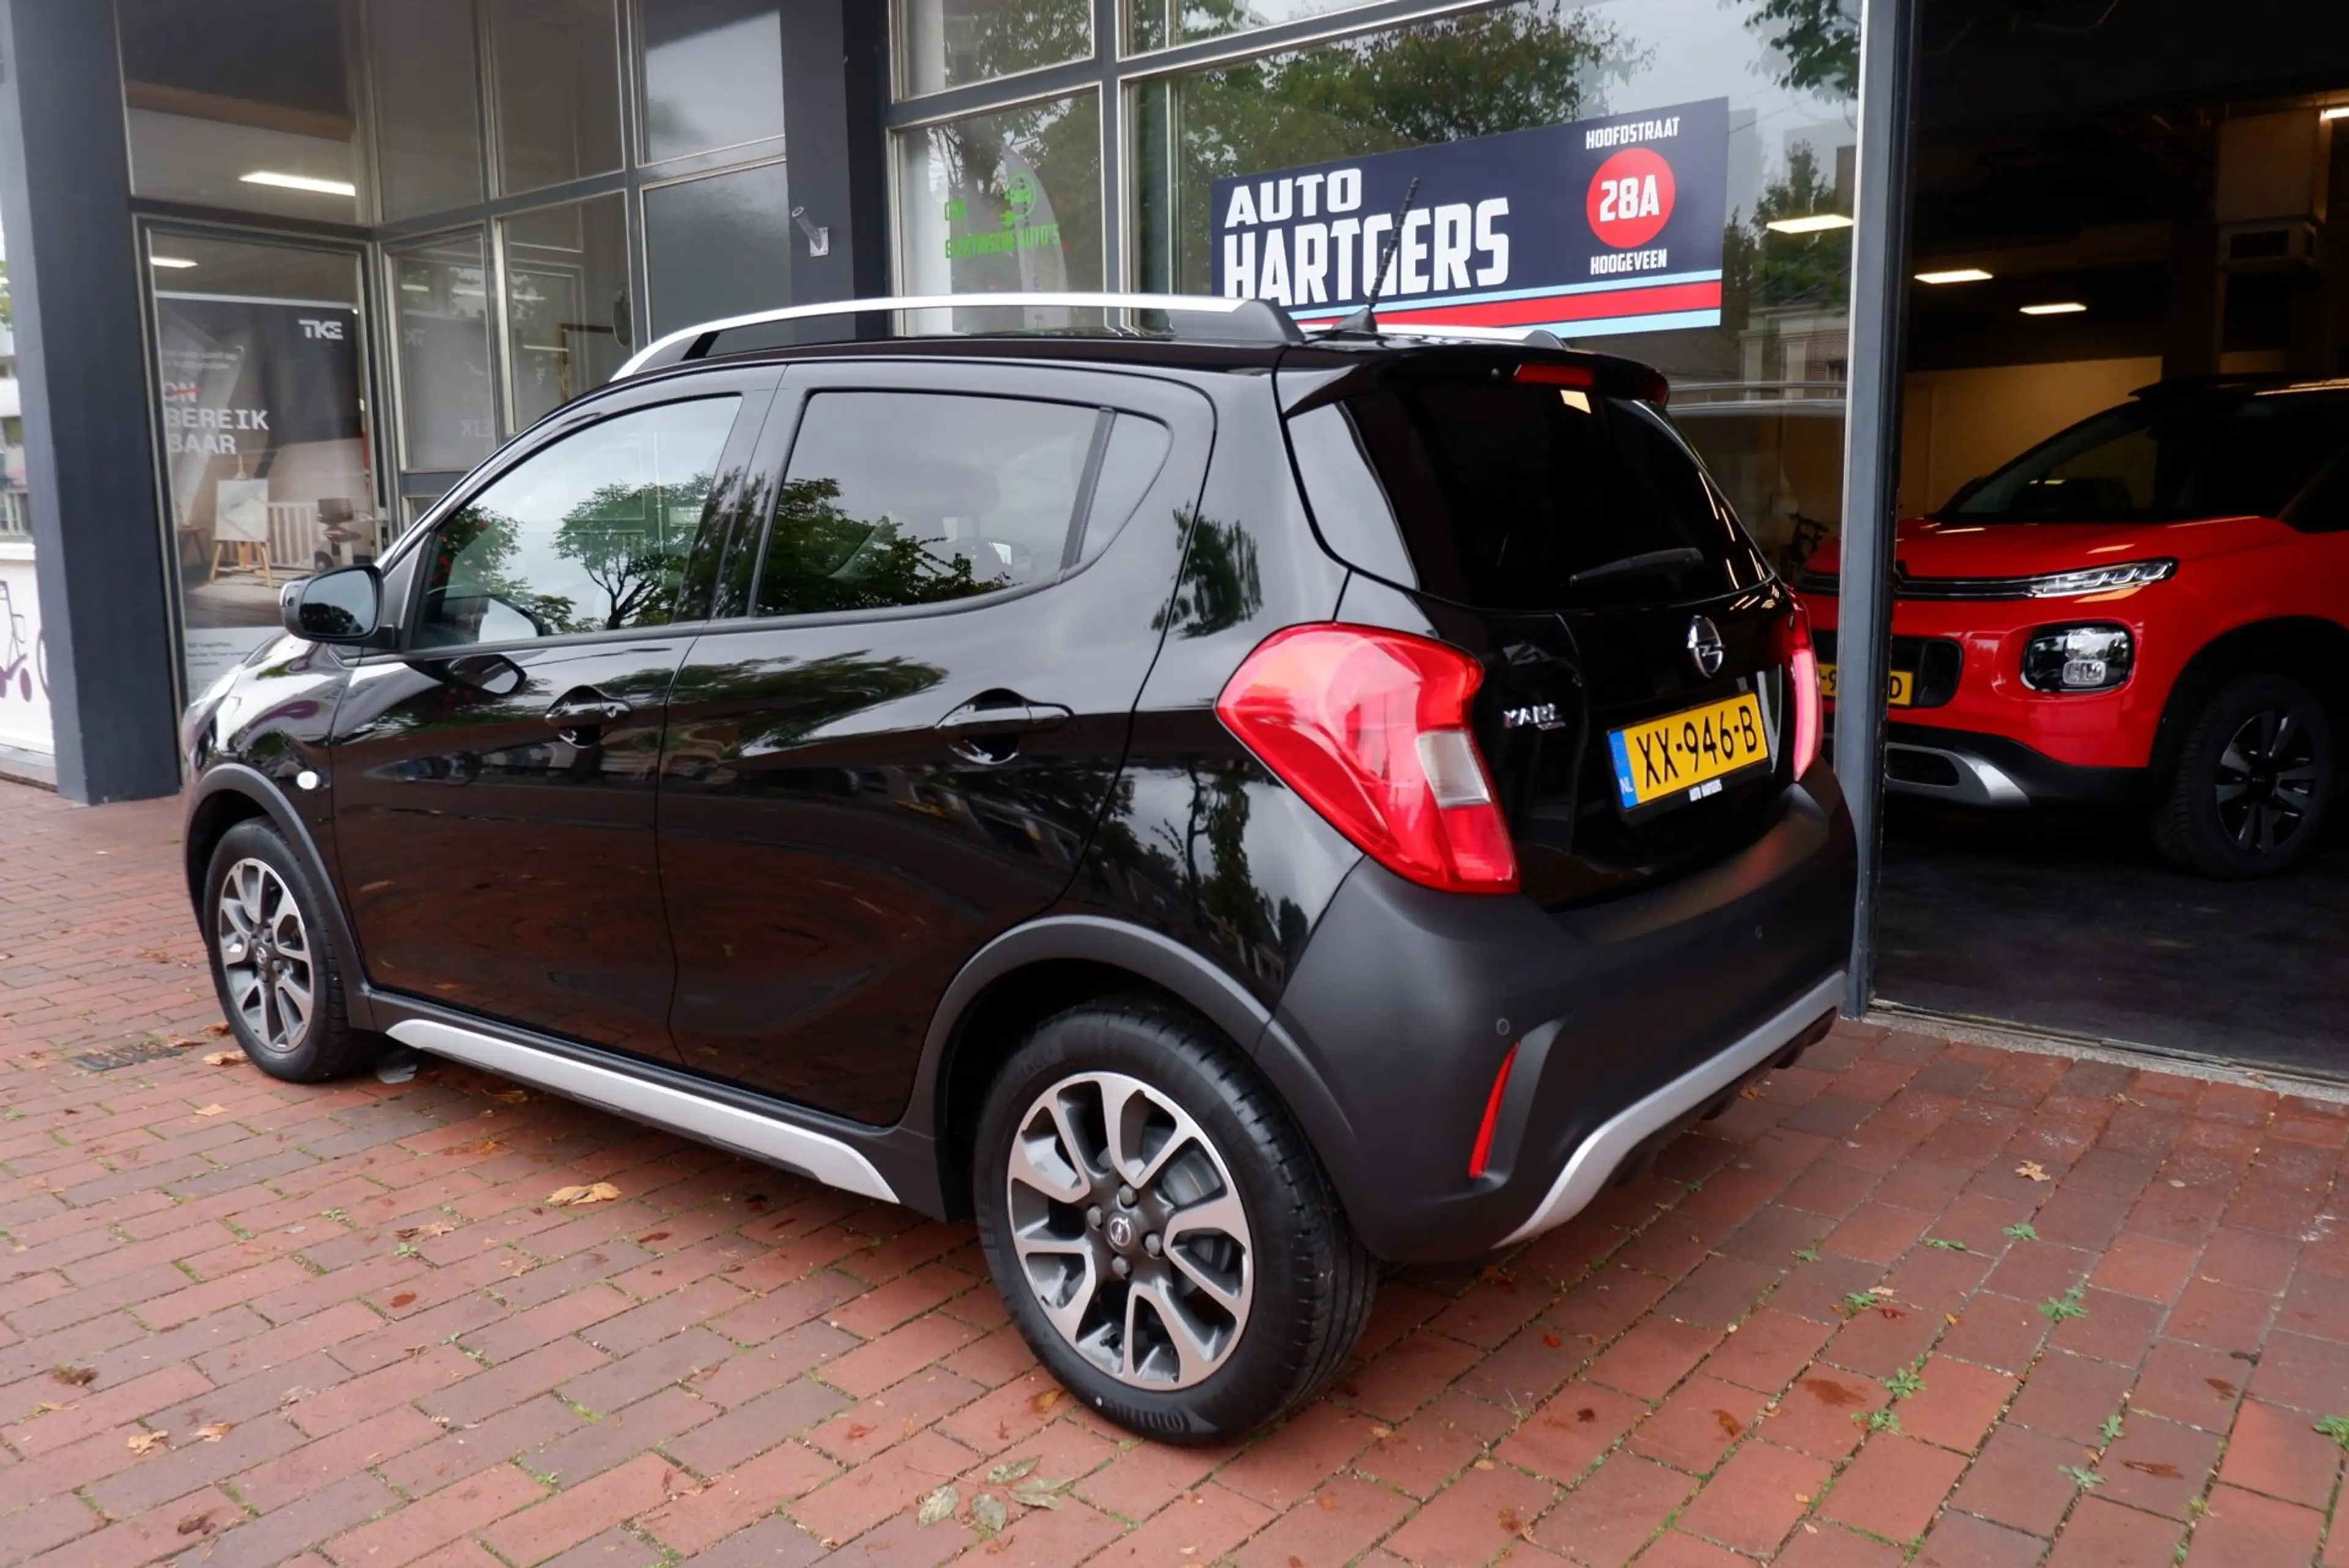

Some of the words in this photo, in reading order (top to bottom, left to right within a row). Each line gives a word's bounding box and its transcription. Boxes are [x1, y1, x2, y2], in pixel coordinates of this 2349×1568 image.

[1586, 116, 1680, 149] HOOFDSTRAAT
[1224, 168, 1362, 228] AUTO
[1600, 174, 1660, 222] 28A
[1224, 197, 1510, 307] HARTGERS
[1590, 248, 1667, 275] HOOGEVEEN
[297, 319, 344, 340] TKE
[165, 407, 270, 431] BEREIK
[168, 433, 237, 455] BAAR
[1636, 705, 1757, 790] XX-946-B
[1619, 776, 1634, 794] NL
